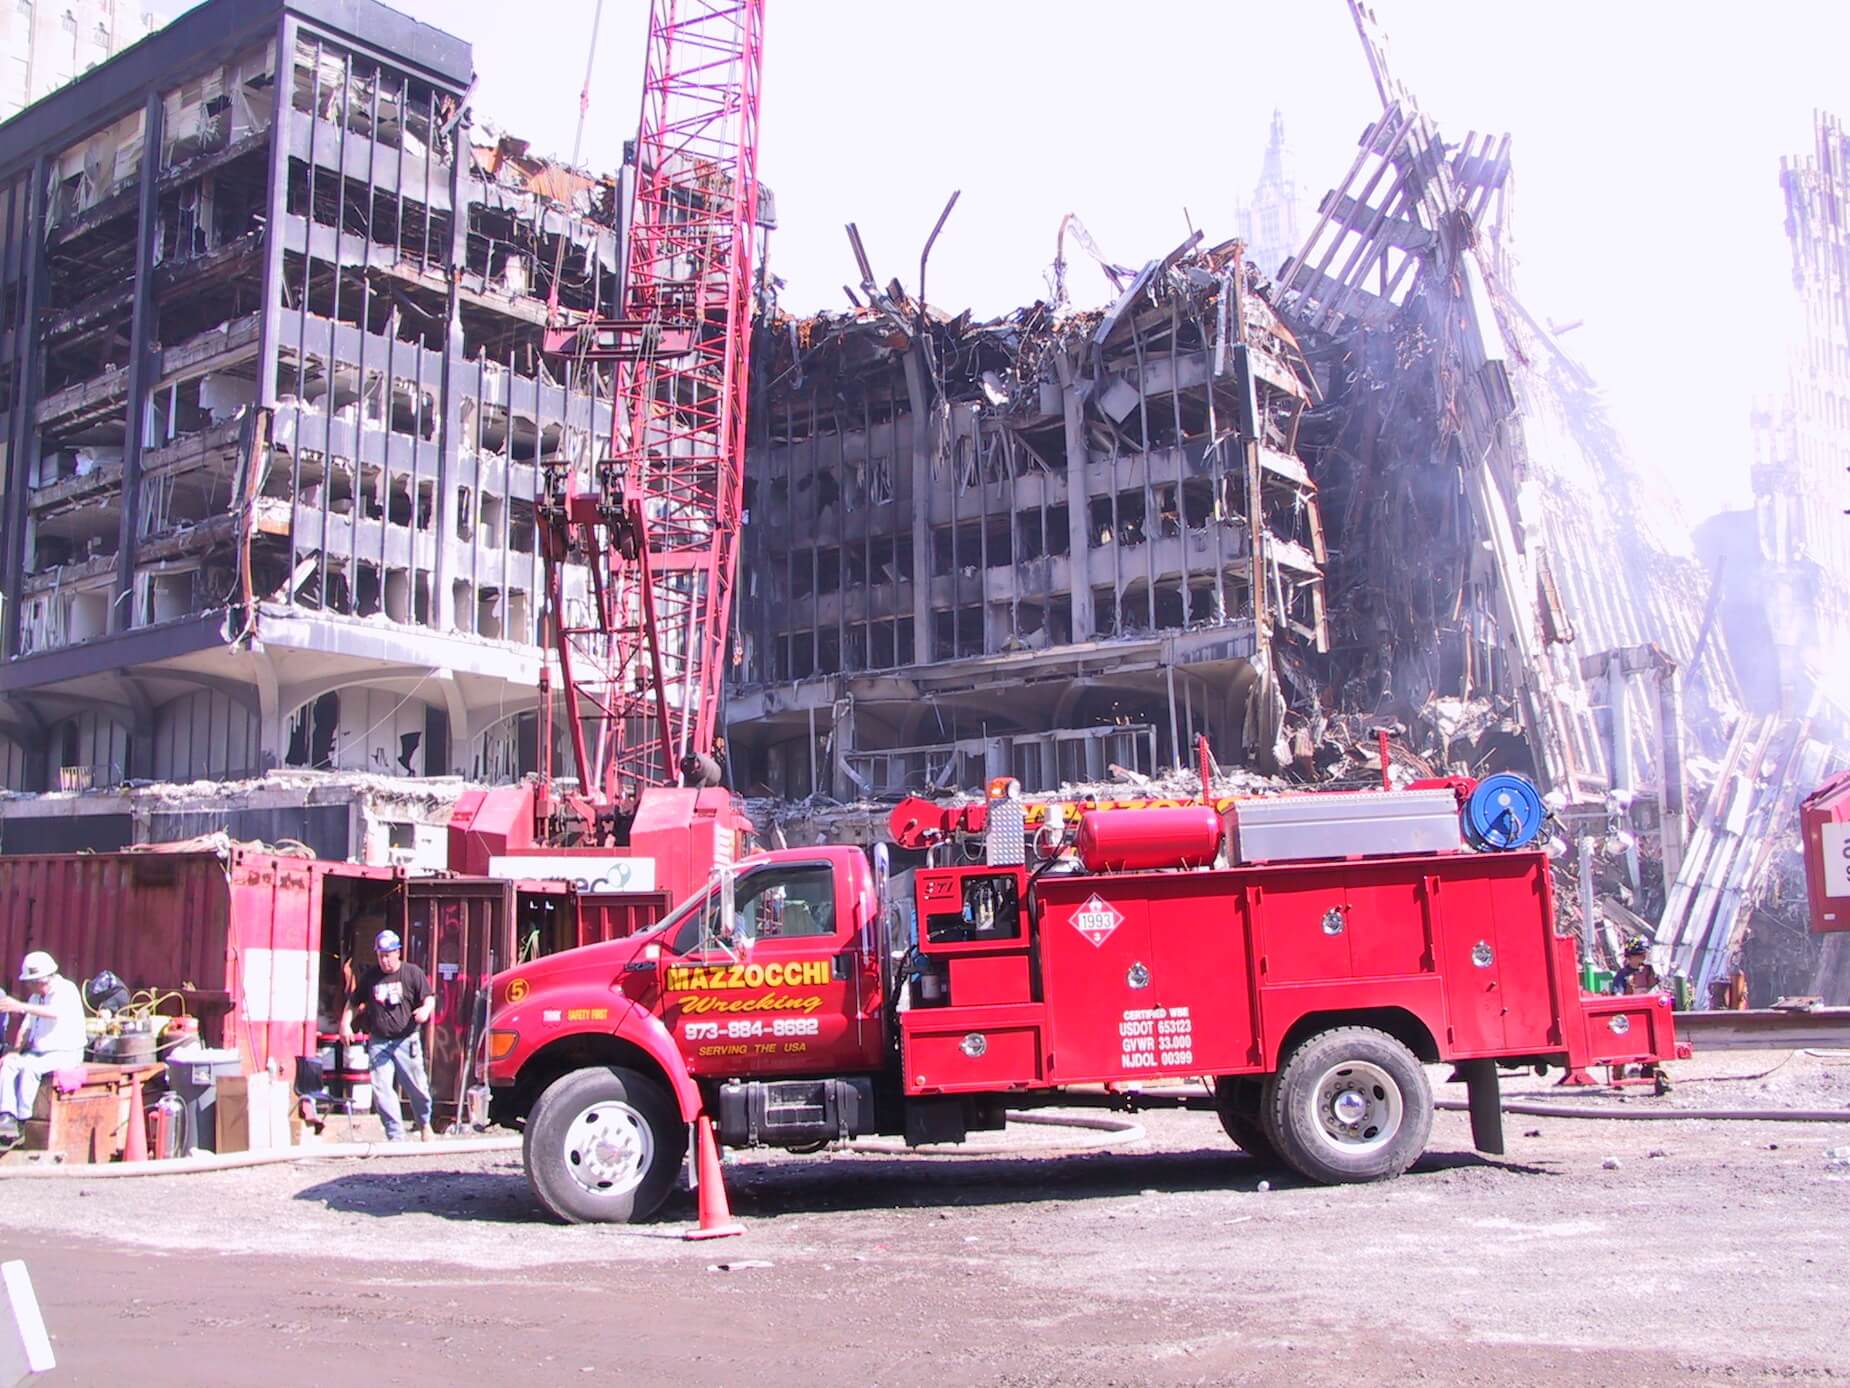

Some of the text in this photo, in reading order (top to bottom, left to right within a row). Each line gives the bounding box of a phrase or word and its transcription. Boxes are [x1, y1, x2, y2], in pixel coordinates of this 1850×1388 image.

[1082, 913, 1111, 929] 1993
[1094, 931, 1102, 942] 3
[668, 961, 830, 990] MAZZOCCHI
[511, 982, 524, 1001] 5
[678, 992, 823, 1014] Wrecking
[685, 1018, 819, 1040] 973-884-8682
[1119, 1021, 1154, 1036] USDOT
[699, 1042, 807, 1056] SERVING THE USA
[1122, 1037, 1155, 1052] GVWR
[1121, 1050, 1193, 1069] NJDOL 00399
